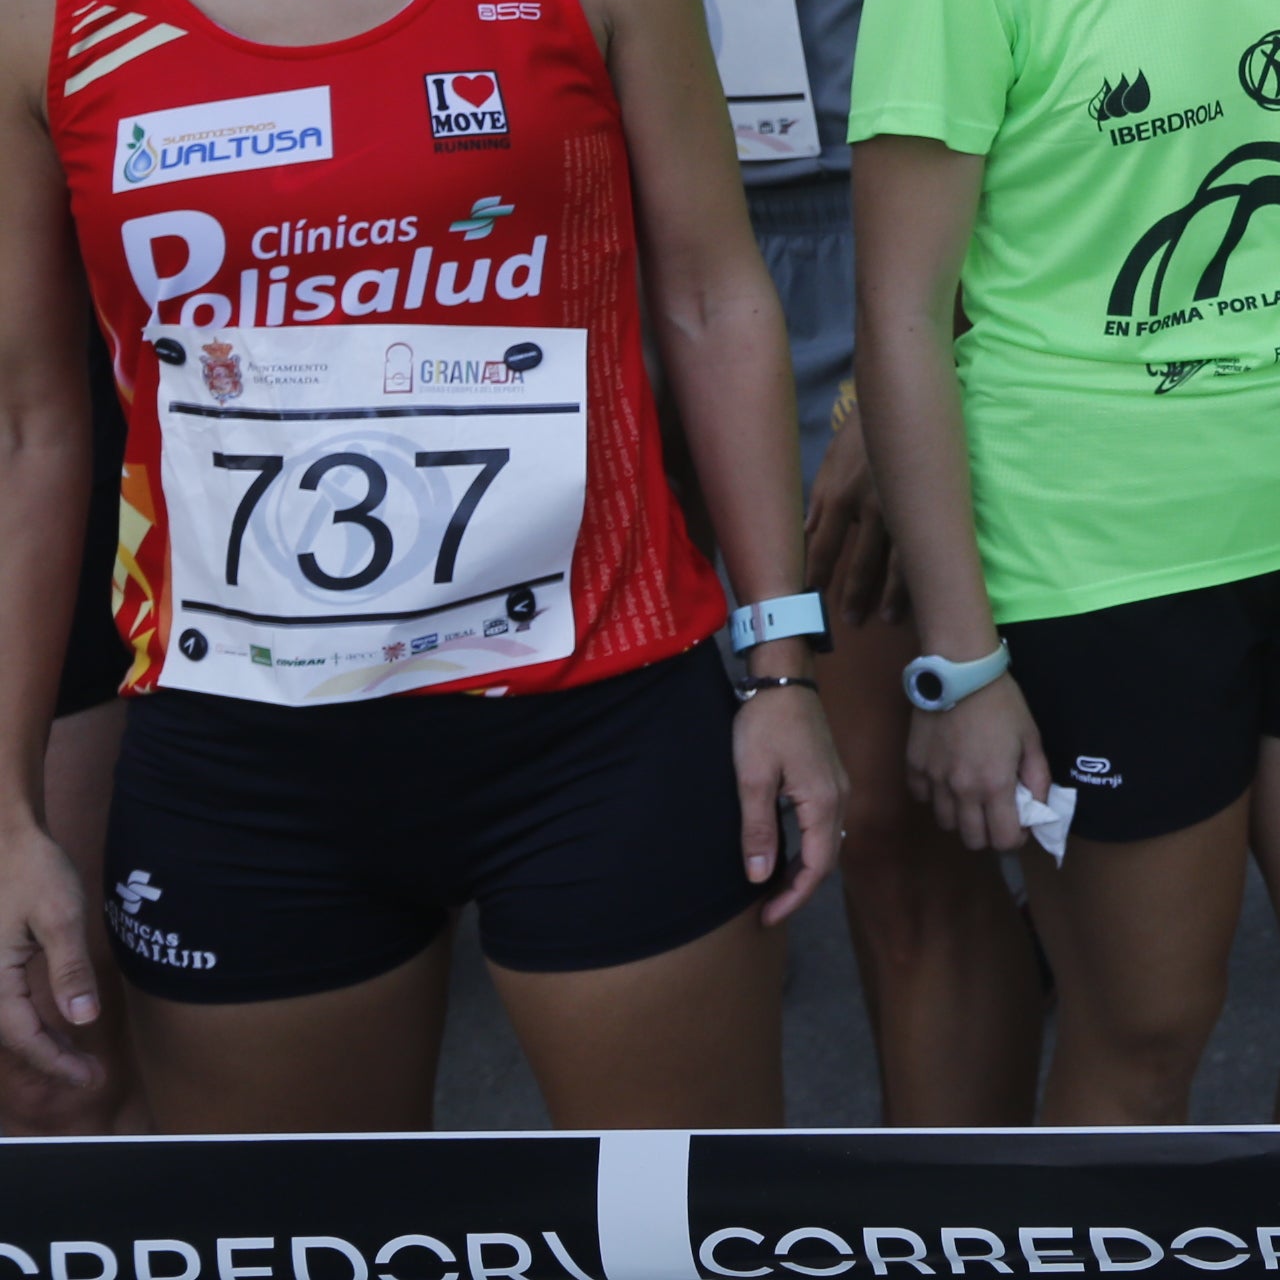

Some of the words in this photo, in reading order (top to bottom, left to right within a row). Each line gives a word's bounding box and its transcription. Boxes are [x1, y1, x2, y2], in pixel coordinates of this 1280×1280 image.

[433, 78, 449, 111] I
[432, 111, 505, 134] MOVE
[1110, 100, 1224, 147] IBERDROLA
[434, 138, 510, 153] RUNNING
[251, 214, 417, 259] Clínicas
[120, 209, 548, 341] Polisalud
[1104, 321, 1129, 336] EN
[1136, 307, 1203, 337] FORMA
[1218, 296, 1257, 316] POR
[420, 359, 525, 385] GRANADA
[212, 448, 510, 591] 737
